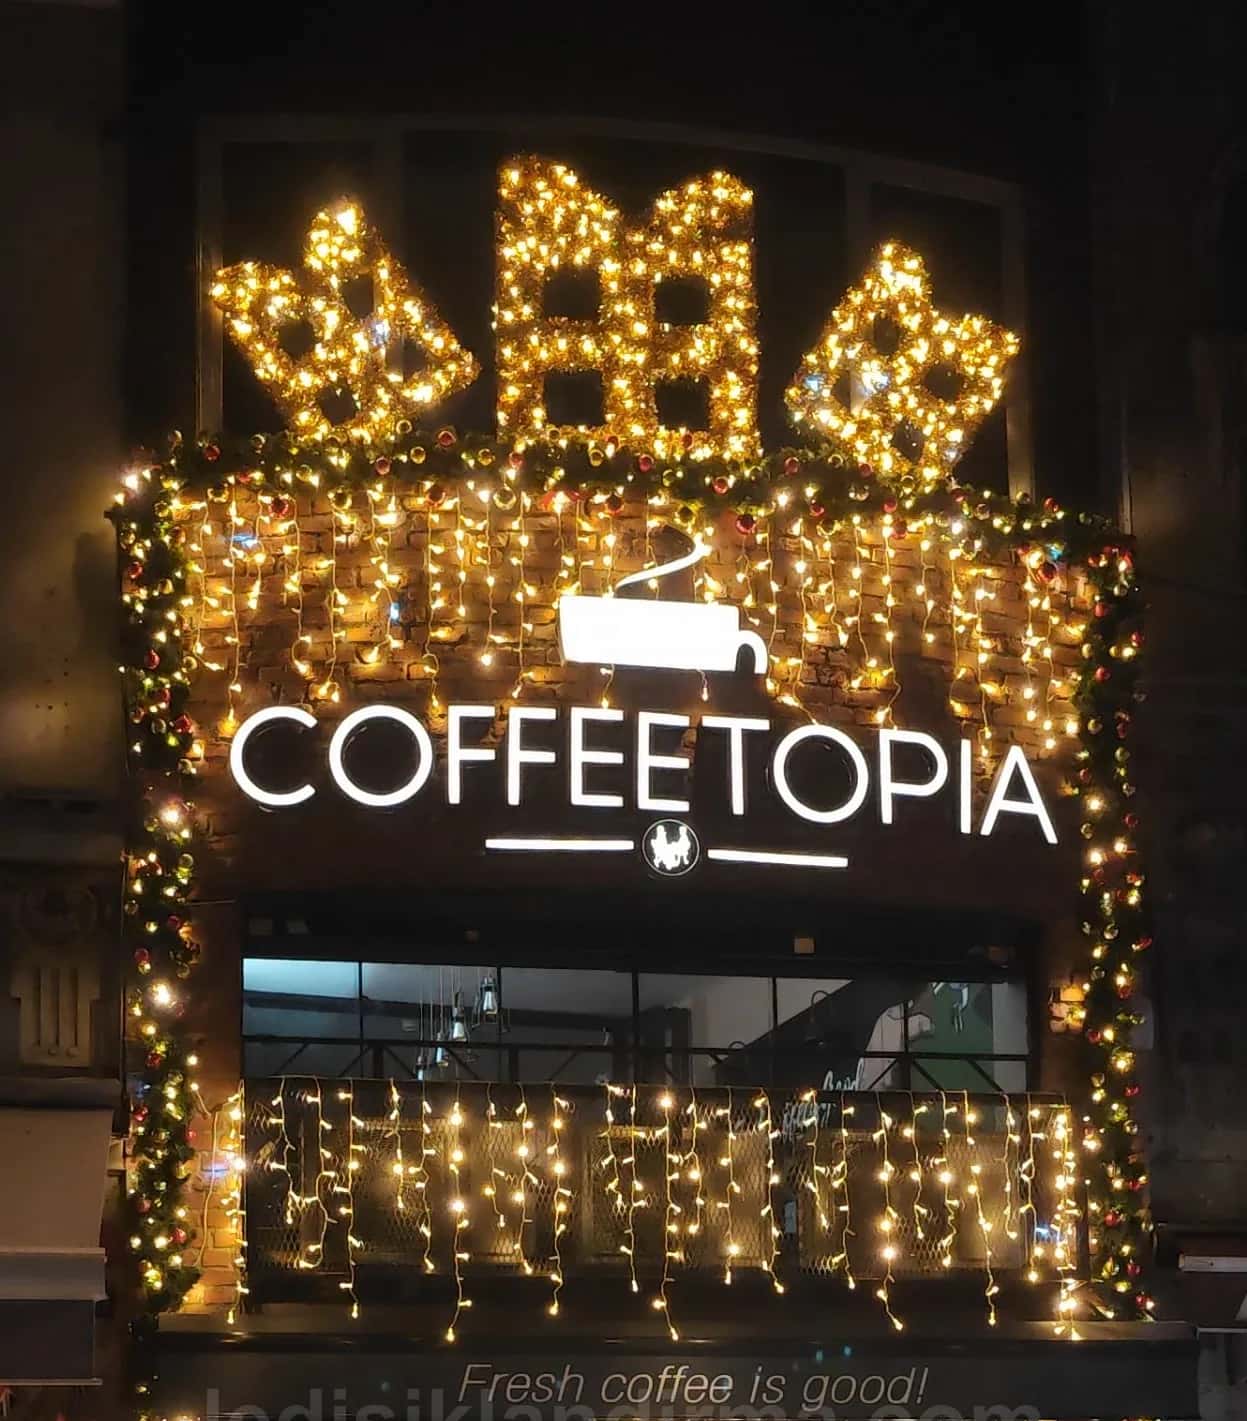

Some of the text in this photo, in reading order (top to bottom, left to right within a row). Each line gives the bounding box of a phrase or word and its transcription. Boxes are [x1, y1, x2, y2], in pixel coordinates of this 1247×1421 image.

[230, 705, 1059, 845] COFFEETOPIA
[457, 1364, 929, 1412] Fresh coffee is good!
